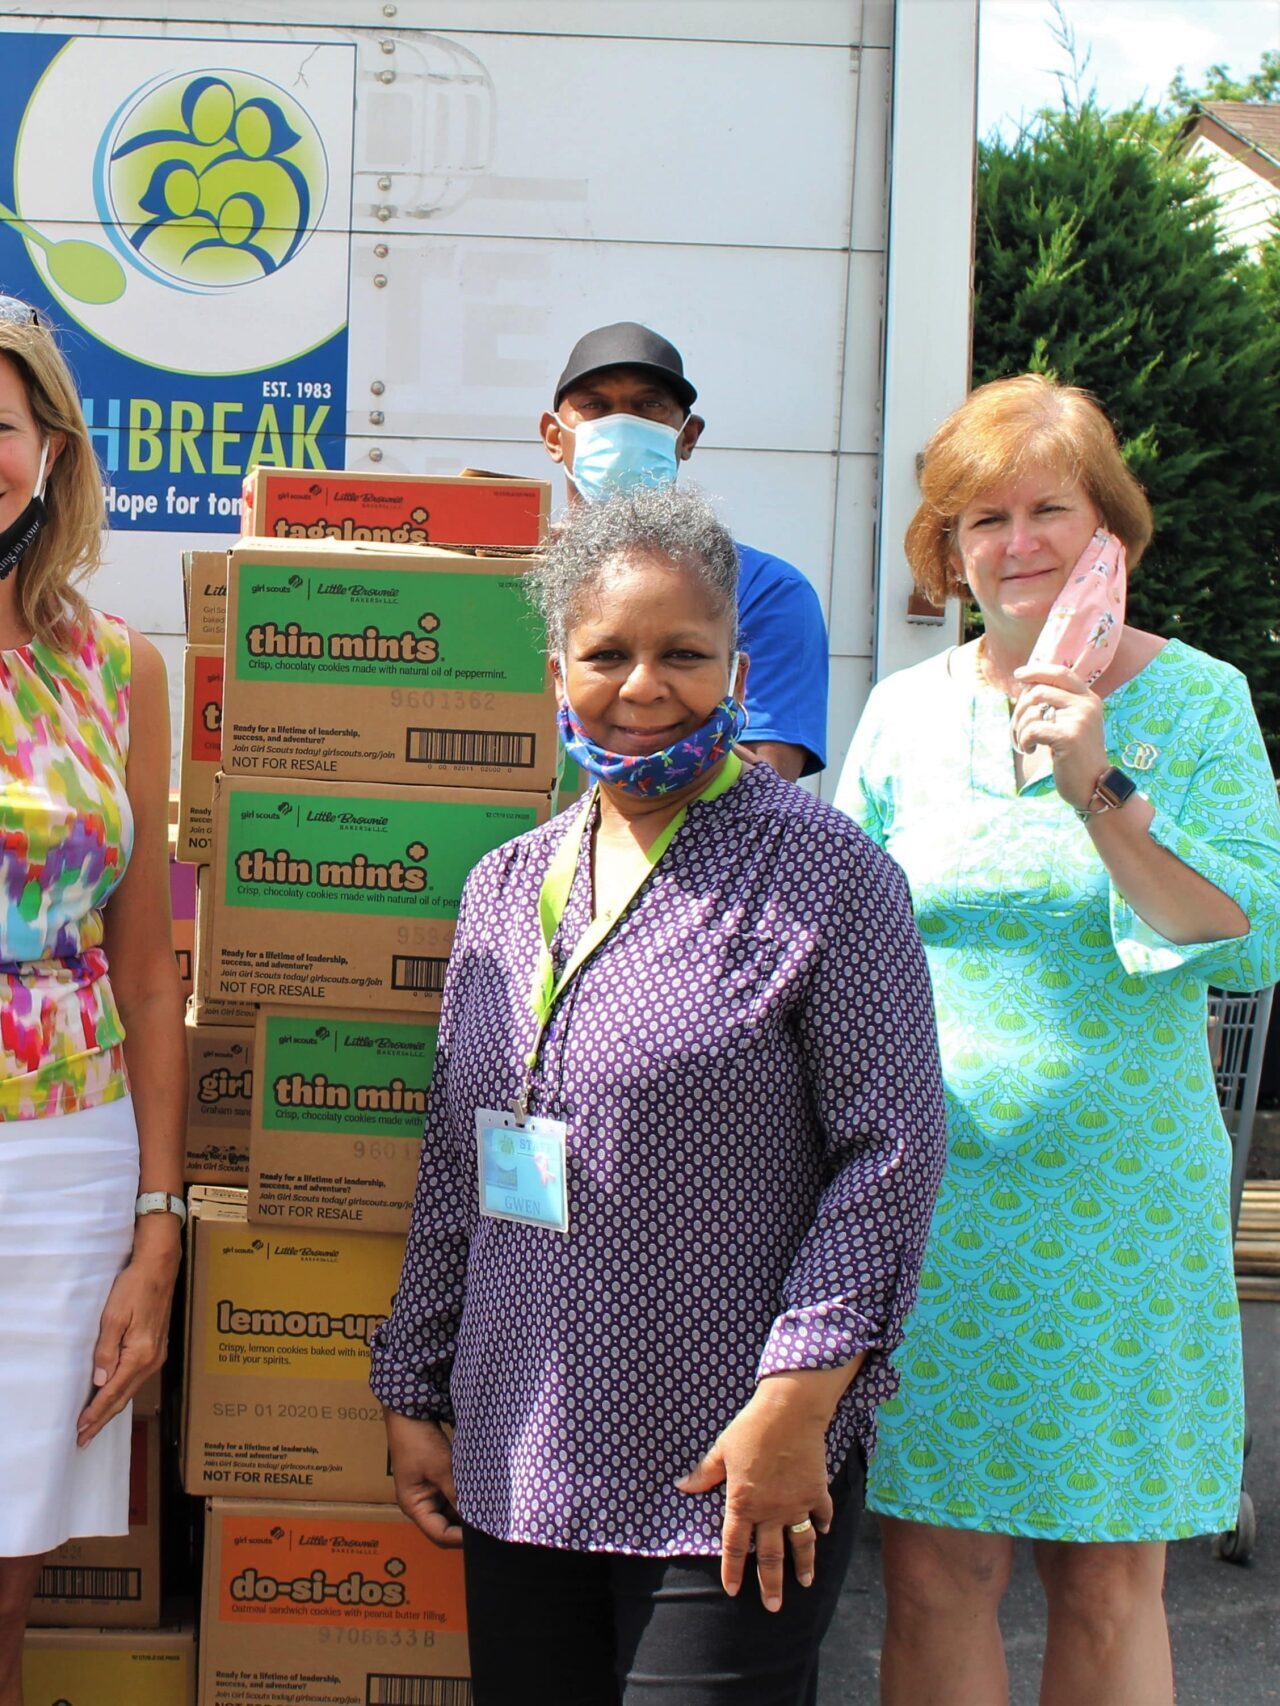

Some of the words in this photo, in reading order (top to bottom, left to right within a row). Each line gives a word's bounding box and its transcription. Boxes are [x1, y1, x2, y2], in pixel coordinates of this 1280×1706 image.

[262, 381, 291, 398] EST.
[297, 382, 331, 399] 1983
[102, 486, 157, 520] Hope
[166, 486, 199, 514] for
[15, 543, 23, 556] in
[23, 520, 40, 545] your
[252, 584, 265, 593] girl
[317, 584, 346, 595] Little
[349, 585, 399, 597] Brownie
[246, 622, 324, 658] thin
[249, 660, 272, 670] Crisp,
[275, 660, 315, 672] chocolaty
[318, 662, 349, 672] cookies
[353, 664, 376, 673] made
[379, 665, 397, 674] with
[400, 666, 429, 675] natural
[432, 668, 441, 676] oil
[443, 668, 452, 677] of
[455, 669, 506, 680] peppermint.
[233, 725, 256, 733] Ready
[278, 726, 306, 734] lifetime
[319, 728, 360, 738] leadership,
[233, 734, 265, 742] success,
[283, 736, 325, 744] adventure?
[322, 749, 395, 760] girlscouts.org/join
[232, 757, 258, 768] NOT
[263, 758, 287, 769] FOR
[291, 759, 337, 771] RESALE
[241, 811, 254, 820] girl
[256, 812, 280, 820] scouts
[307, 811, 336, 822] Little
[338, 813, 388, 825] Brownie
[235, 848, 311, 885] thin
[238, 886, 261, 896] Crisp,
[264, 887, 303, 899] chocolaty
[306, 890, 337, 900] cookies
[341, 892, 364, 901] made
[367, 893, 384, 903] with
[387, 895, 417, 904] natural
[420, 896, 429, 904] oil
[432, 897, 441, 905] of
[222, 949, 244, 958] Ready
[266, 952, 294, 960] lifetime
[297, 953, 305, 961] of
[306, 954, 348, 965] leadership,
[222, 959, 253, 967] success,
[283, 973, 309, 982] today!
[310, 975, 382, 986] girlscouts.org/join
[220, 981, 246, 992] NOT
[250, 983, 275, 995] FOR
[279, 986, 325, 997] RESALE
[279, 1035, 292, 1045] girl
[344, 1036, 373, 1047] Little
[375, 1038, 425, 1050] Brownie
[198, 1068, 253, 1104] girl
[274, 1073, 350, 1109] thin
[355, 1077, 429, 1113] min
[201, 1106, 233, 1115] Graham
[276, 1110, 299, 1120] Crisp,
[302, 1111, 342, 1123] chocolaty
[345, 1113, 376, 1123] cookies
[379, 1116, 402, 1125] made
[405, 1117, 422, 1126] with
[505, 1196, 541, 1214] GWEN
[259, 1205, 284, 1216] NOT
[289, 1206, 312, 1217] FOR
[317, 1208, 363, 1220] RESALE
[217, 1299, 389, 1346] lemon-up
[219, 1343, 246, 1353] Crispy,
[249, 1344, 274, 1352] lemon
[277, 1346, 308, 1355] cookies
[311, 1347, 335, 1356] baked
[338, 1348, 355, 1356] with
[219, 1354, 227, 1362] to
[230, 1354, 240, 1362] lift
[243, 1356, 261, 1364] your
[263, 1356, 291, 1364] spirits.
[213, 1404, 247, 1416] SEP
[255, 1404, 272, 1417] 01
[279, 1404, 317, 1417] 2020
[322, 1406, 332, 1419] E
[203, 1471, 231, 1481] NOT
[234, 1472, 260, 1482] FOR
[264, 1473, 313, 1485] RESALE
[235, 1536, 247, 1545] girl
[299, 1535, 327, 1546] Little
[330, 1537, 379, 1547] Brownie
[230, 1568, 406, 1607] do-si-dos
[232, 1605, 266, 1613] Oatmeal
[270, 1605, 308, 1615] sandwich
[311, 1607, 341, 1616] cookies
[344, 1608, 361, 1617] with
[364, 1610, 392, 1619] peanut
[395, 1610, 420, 1619] butter
[423, 1611, 447, 1623] filling.
